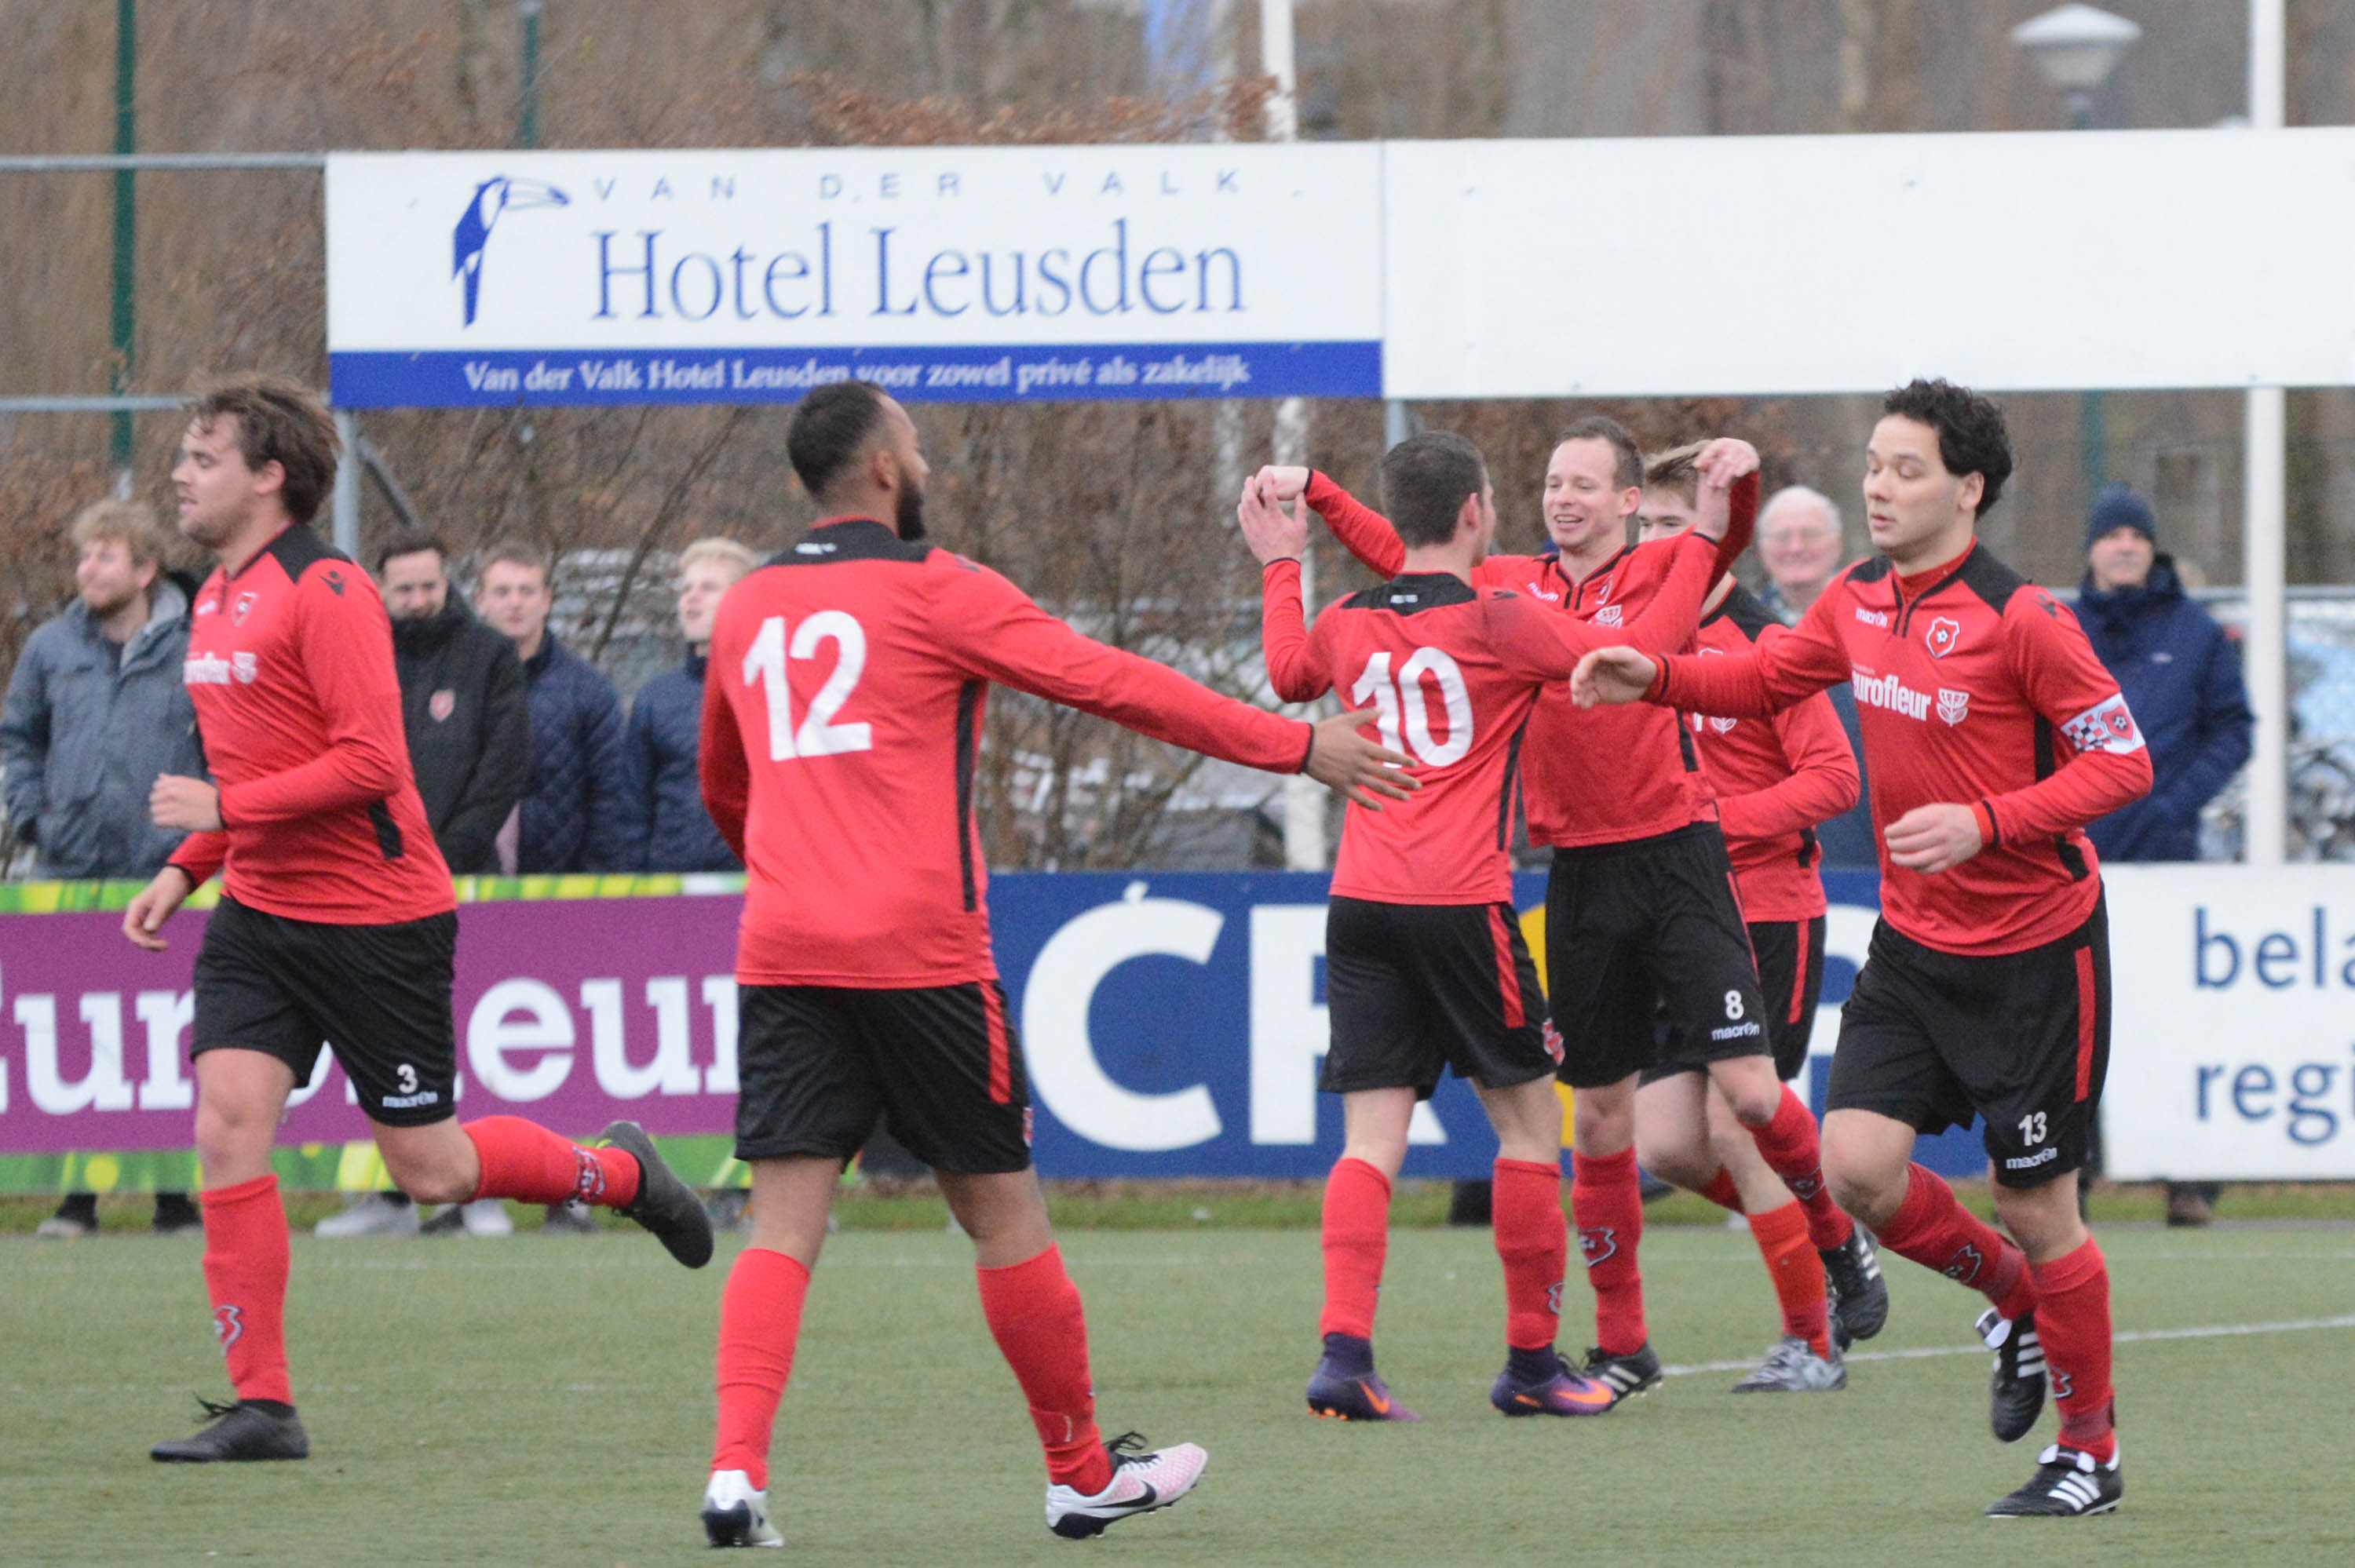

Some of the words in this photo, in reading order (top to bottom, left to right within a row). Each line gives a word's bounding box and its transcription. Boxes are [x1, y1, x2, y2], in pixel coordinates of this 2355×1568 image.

[594, 177, 735, 200] VAN
[819, 173, 959, 199] DER
[1043, 170, 1240, 194] VALK
[590, 221, 838, 321] Hotel
[869, 217, 1246, 316] Leusden
[464, 361, 518, 390] Van
[524, 360, 574, 389] der
[579, 359, 642, 388] Valk
[648, 359, 725, 388] Hotel
[732, 358, 849, 388] Leusden
[856, 365, 922, 386] voor
[926, 356, 1012, 385] zowel
[1015, 357, 1094, 393] privé
[1097, 356, 1138, 384] als
[1142, 354, 1251, 391] zakelijk
[743, 610, 872, 762] 12
[1352, 647, 1473, 768] 10
[1725, 989, 1744, 1020] 8
[1711, 1022, 1760, 1041] macron
[396, 1063, 418, 1095] 3
[2017, 1110, 2048, 1147] 13
